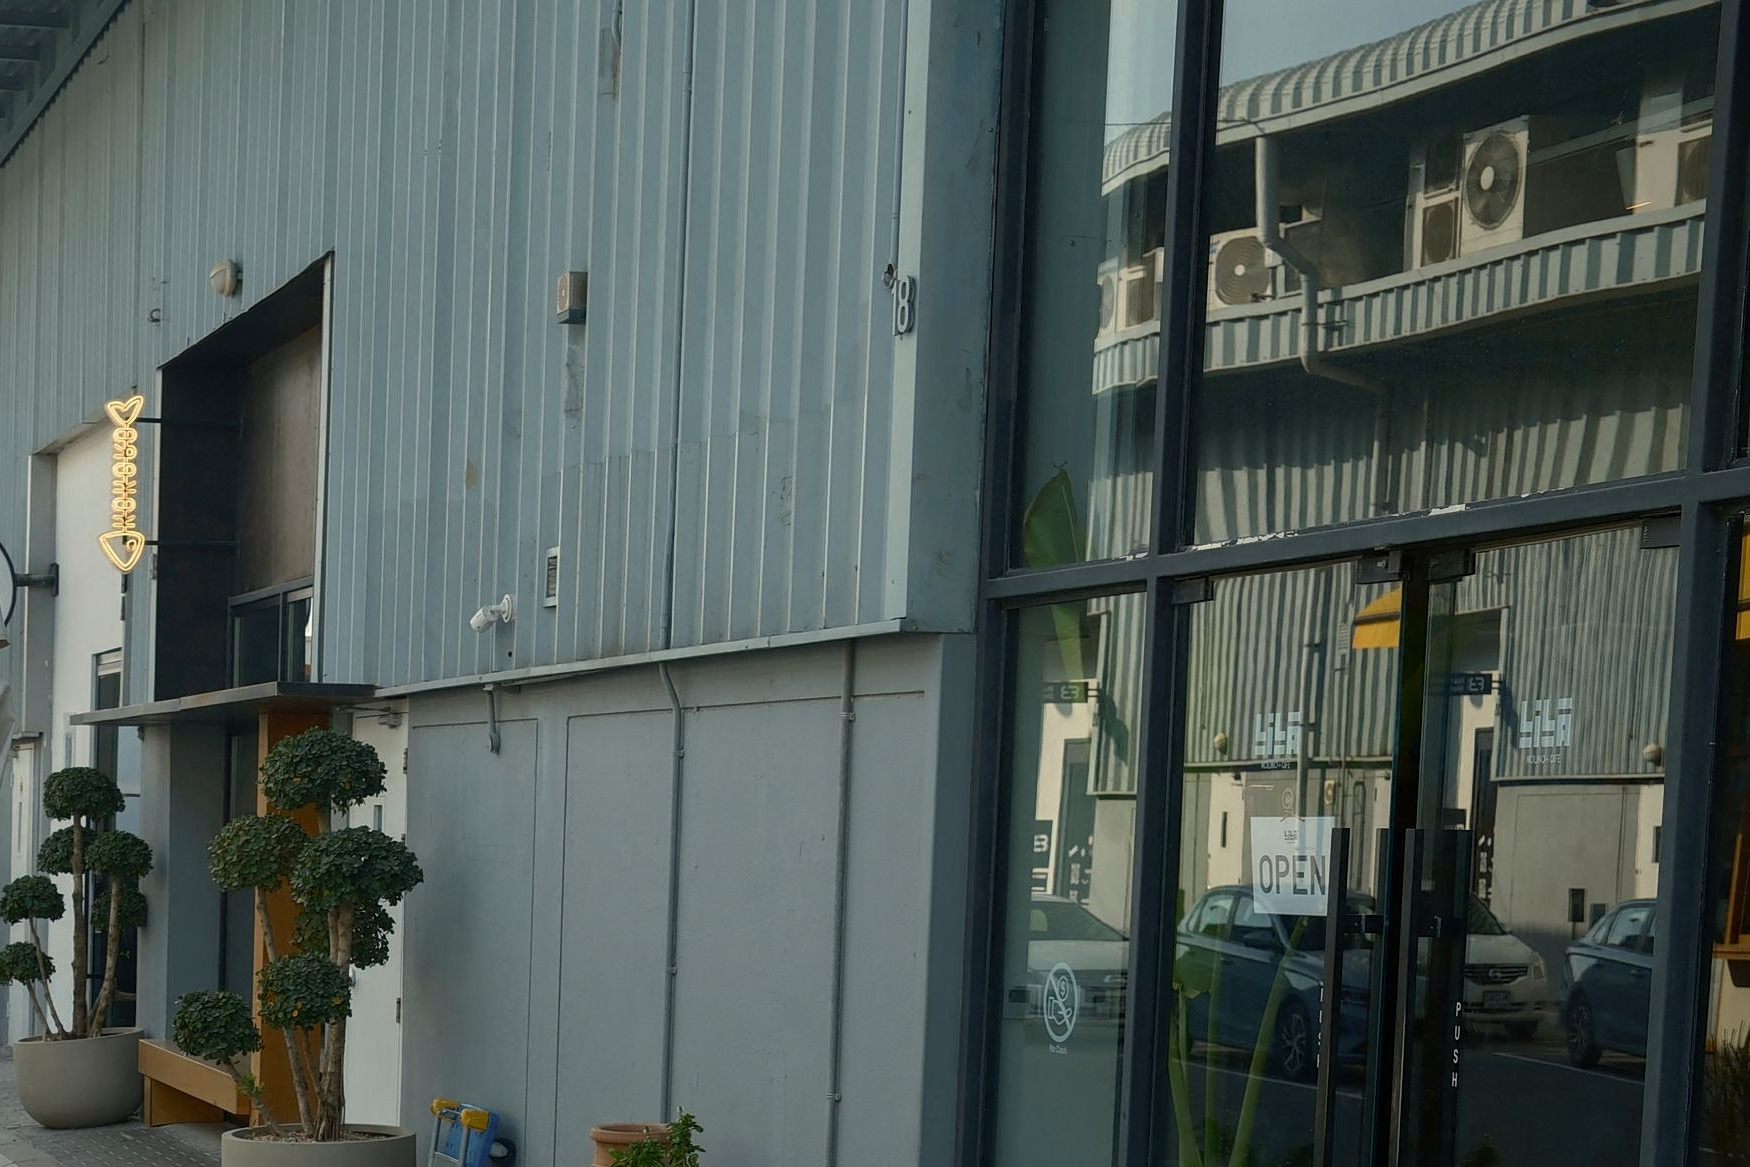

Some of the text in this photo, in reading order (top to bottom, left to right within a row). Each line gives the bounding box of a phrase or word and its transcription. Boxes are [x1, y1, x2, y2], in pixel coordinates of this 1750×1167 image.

[891, 275, 915, 336] 18
[1259, 854, 1326, 895] OPEN
[1451, 1001, 1462, 1088] PUSH
